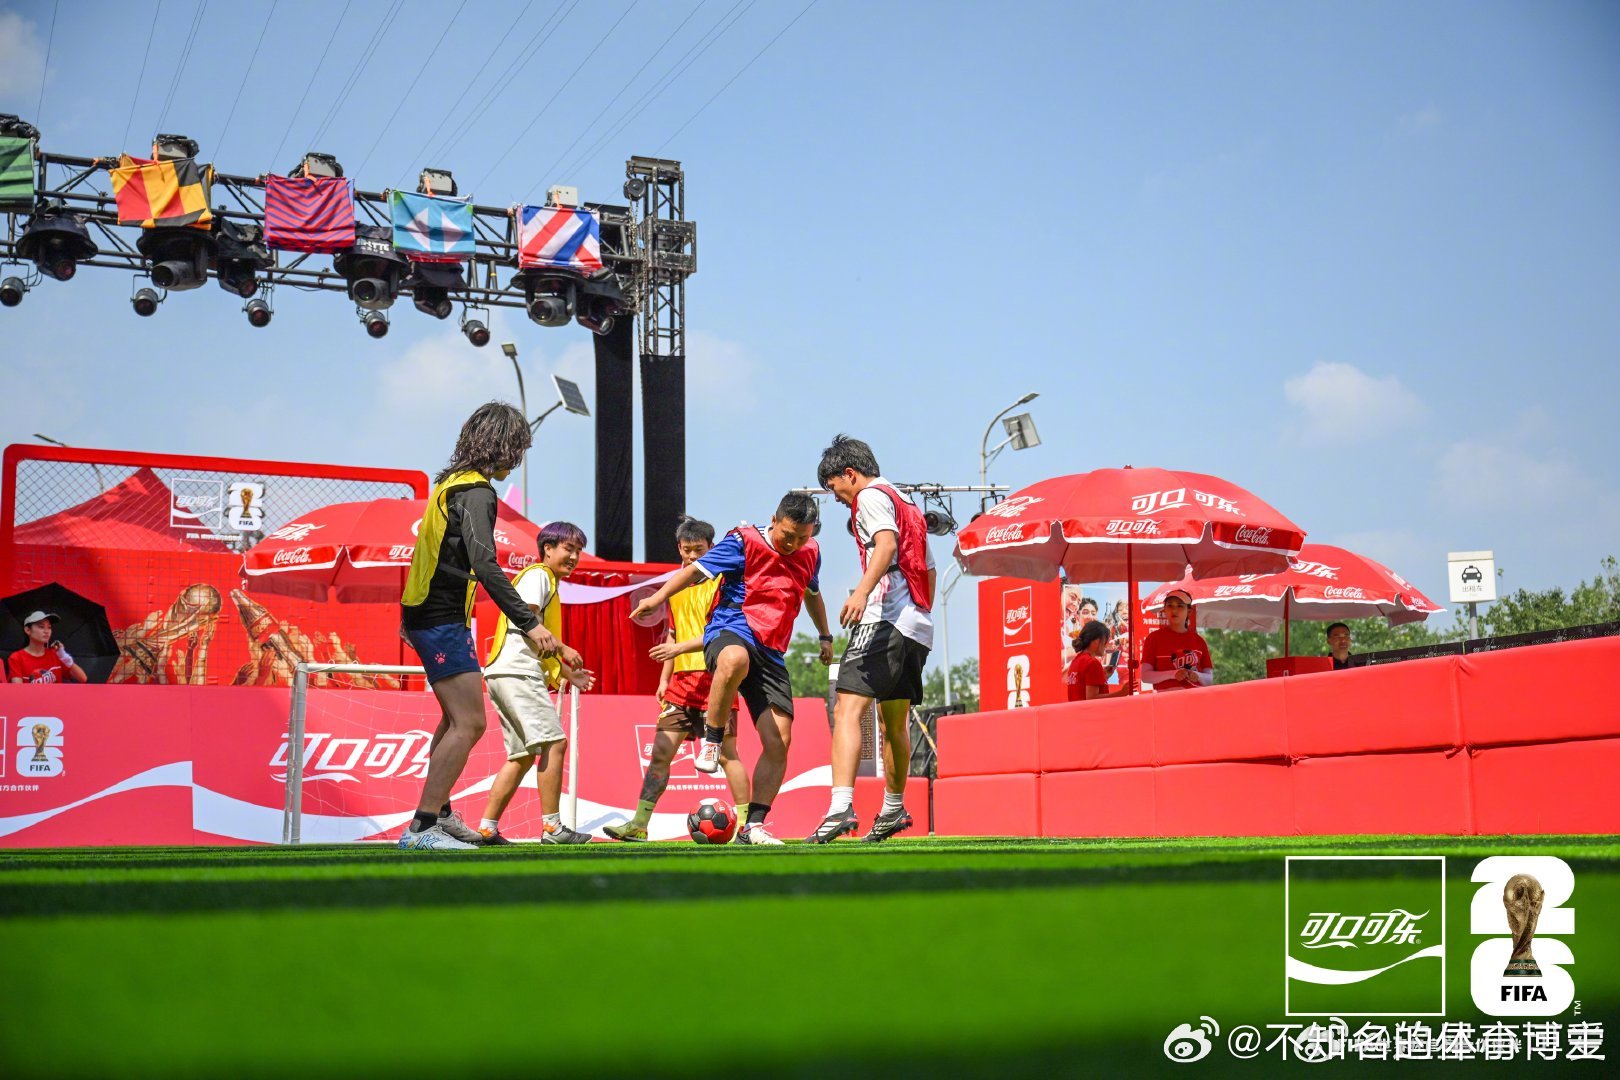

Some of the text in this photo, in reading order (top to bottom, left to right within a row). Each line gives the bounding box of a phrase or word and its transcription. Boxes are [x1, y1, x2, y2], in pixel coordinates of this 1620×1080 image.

[1106, 519, 1163, 535] 可口可乐
[1324, 586, 1364, 598] Coca-Cola
